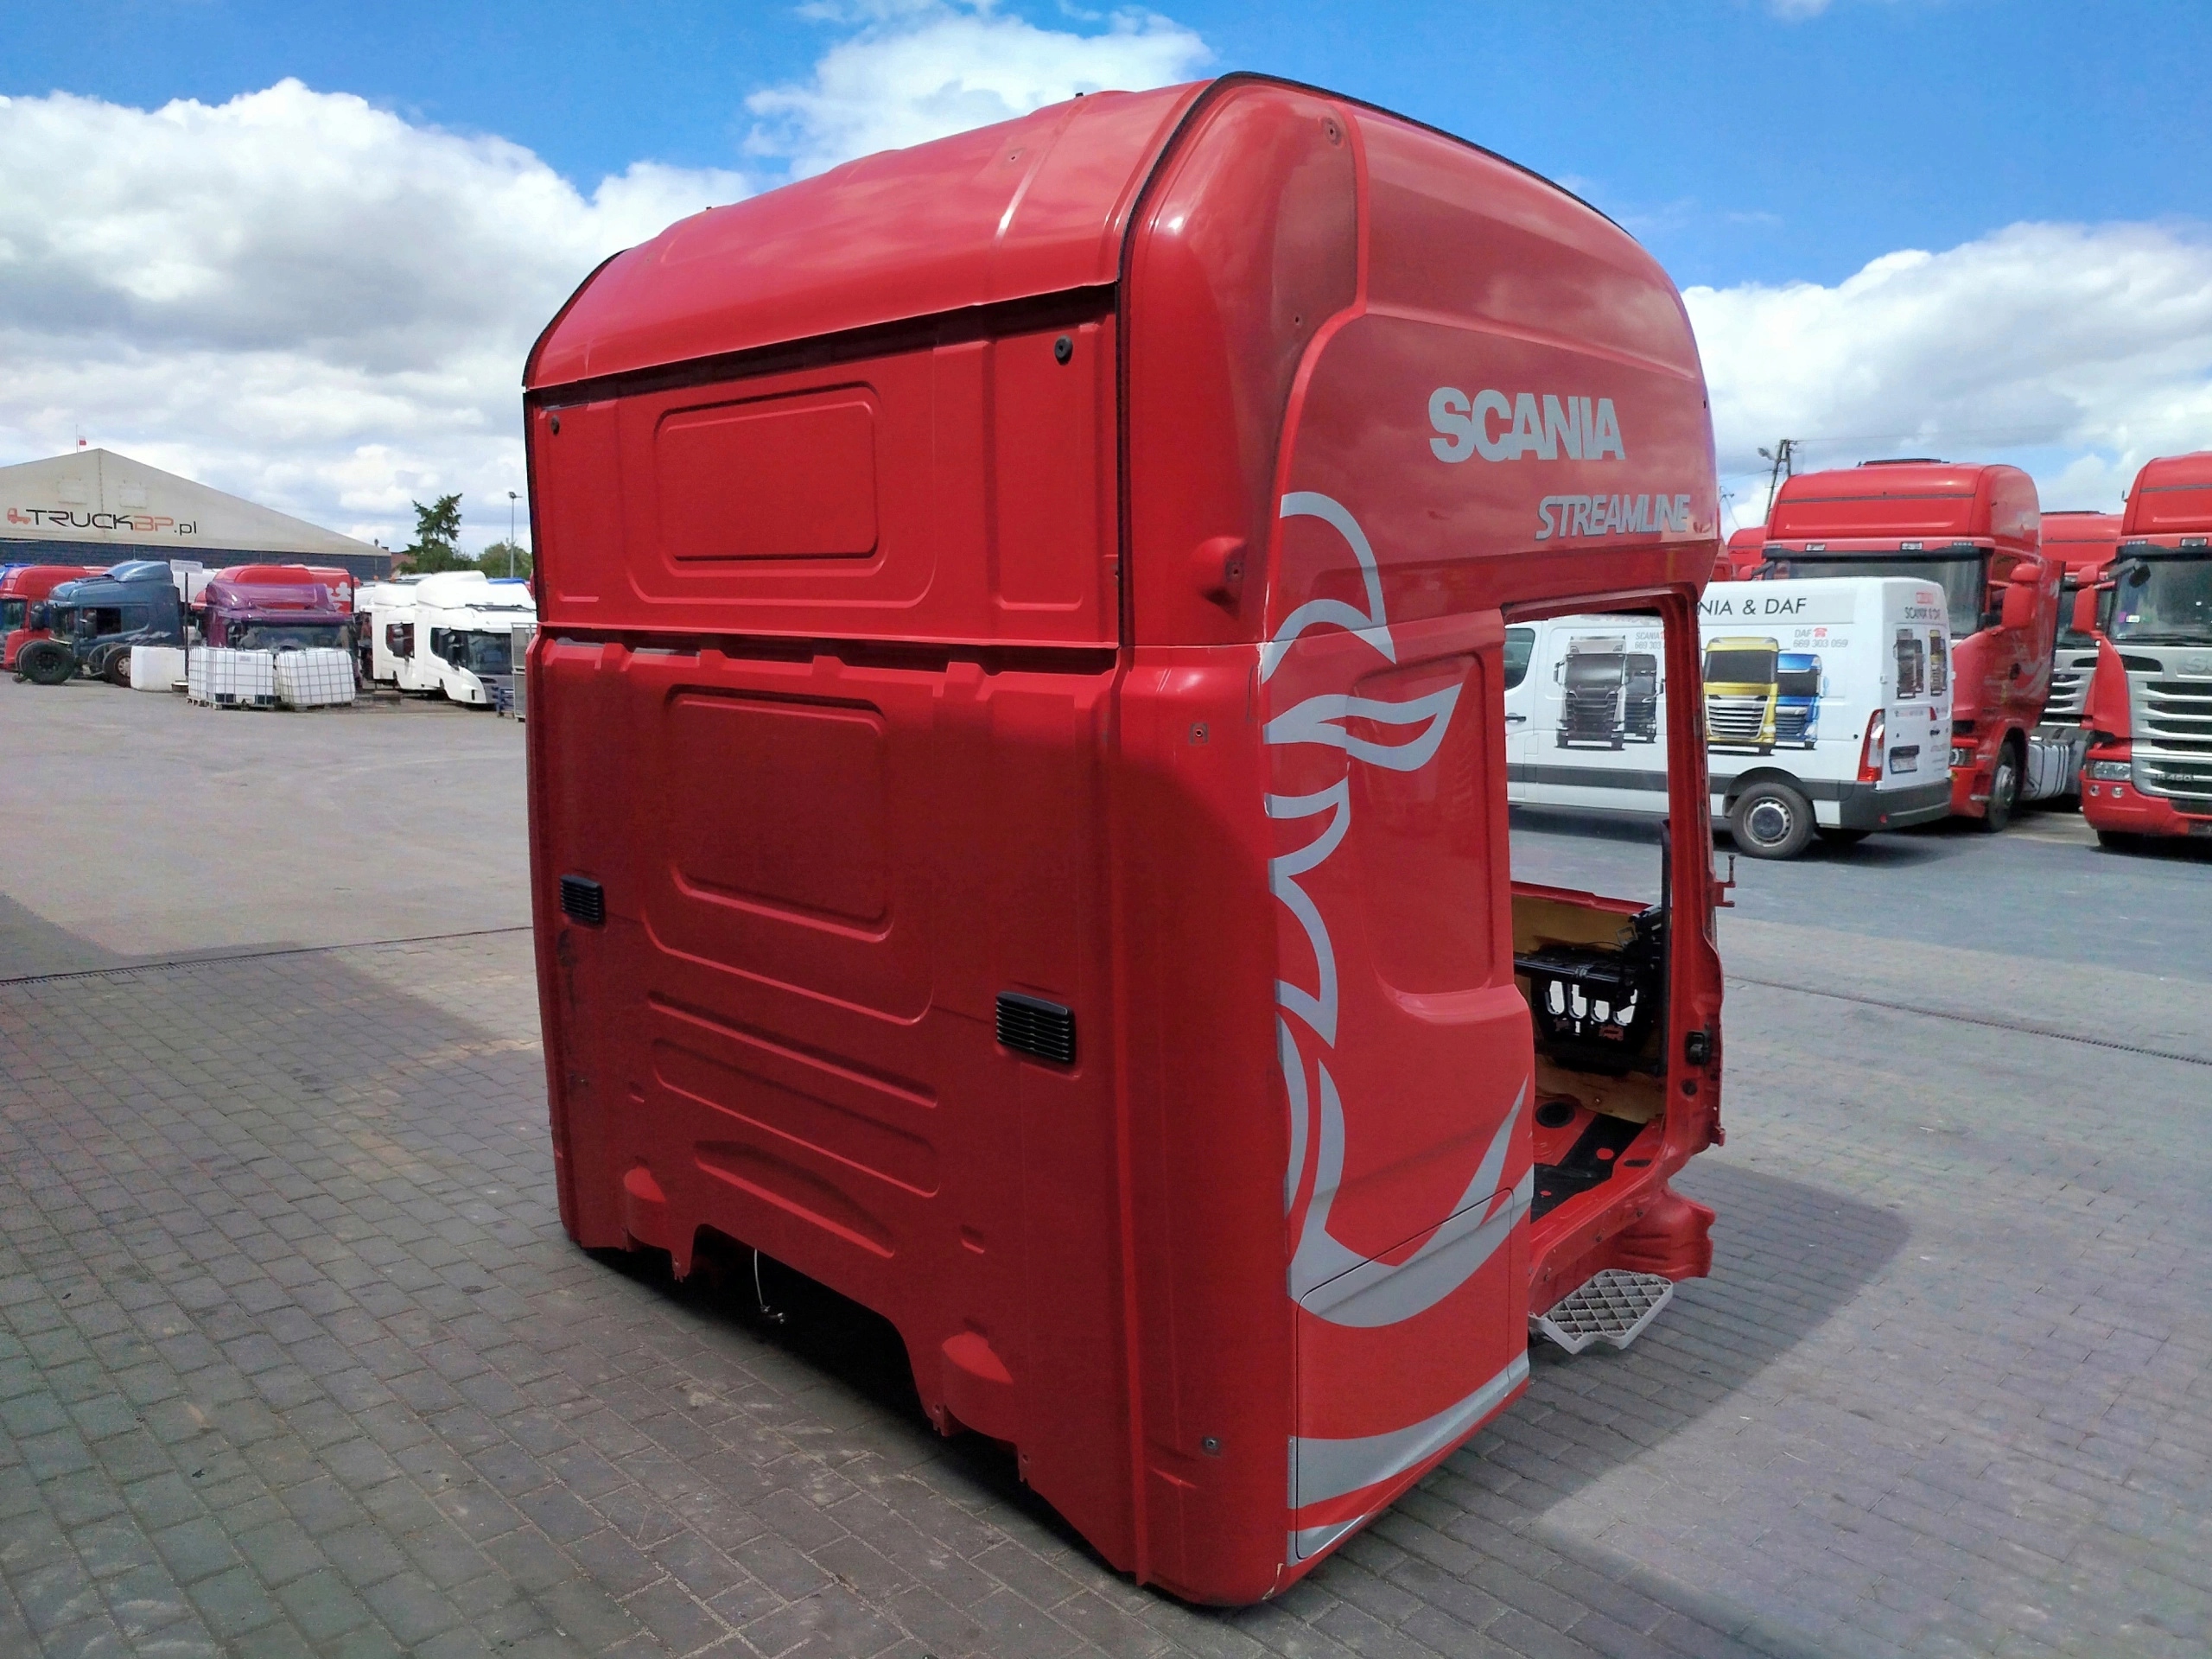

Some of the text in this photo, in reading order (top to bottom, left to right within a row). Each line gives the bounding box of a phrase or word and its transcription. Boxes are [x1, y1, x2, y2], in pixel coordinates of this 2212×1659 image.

[1428, 386, 1624, 463] SCANIA
[26, 508, 197, 536] TRUCKBP.pl
[1535, 494, 1691, 540] STREAMLINE
[1743, 599, 1756, 615] &
[1764, 598, 1807, 614] DAF
[1636, 632, 1660, 640] SCANIA
[1795, 629, 1812, 638] DAF
[1812, 639, 1829, 648] 303
